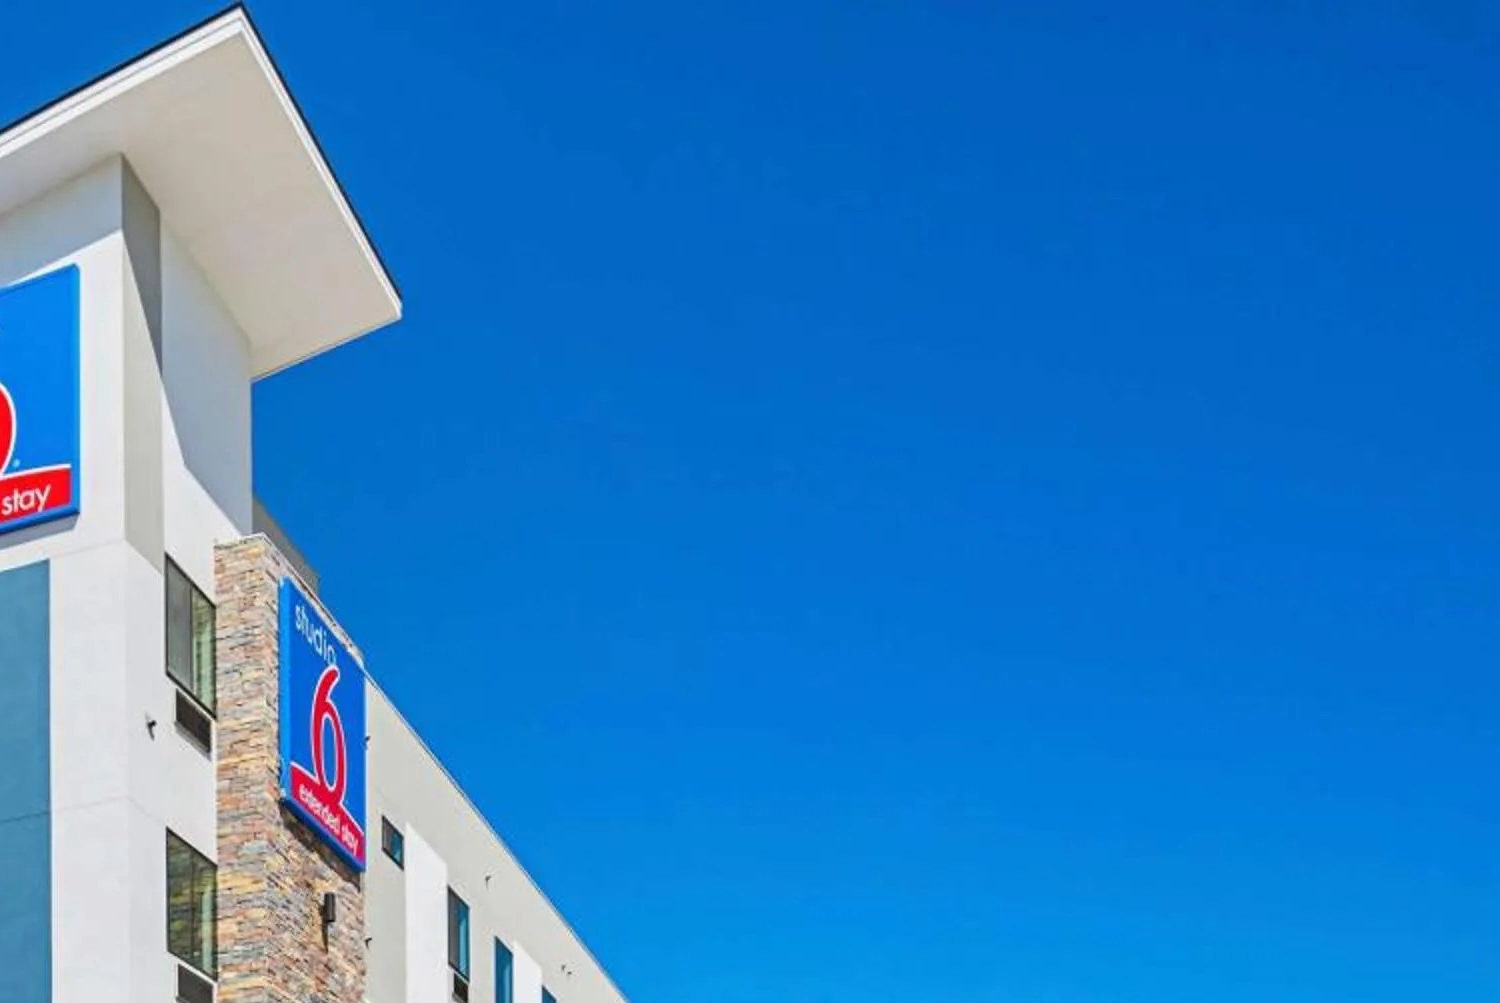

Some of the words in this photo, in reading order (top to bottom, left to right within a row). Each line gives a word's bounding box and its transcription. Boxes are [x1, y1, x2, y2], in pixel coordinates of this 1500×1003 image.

[1, 484, 52, 516] stay
[294, 602, 337, 666] studio
[311, 664, 348, 804] 6
